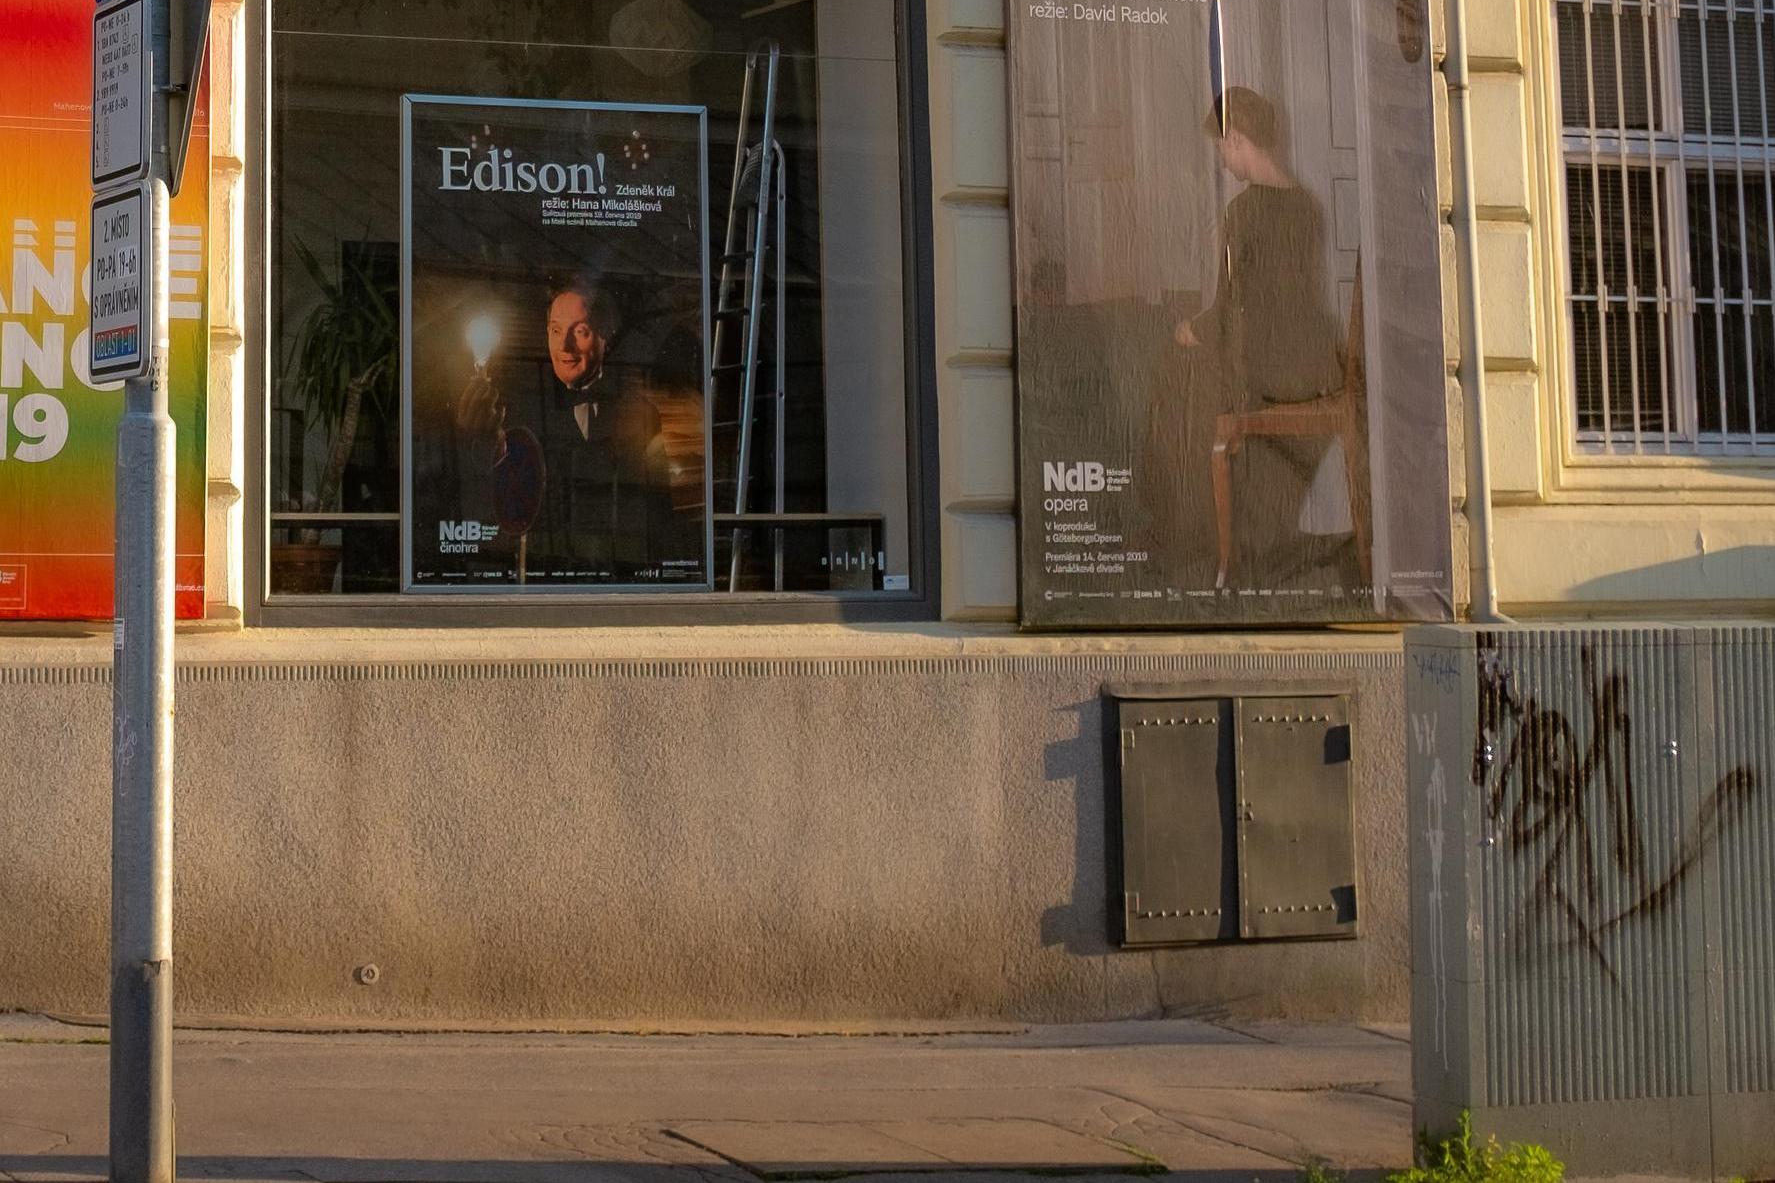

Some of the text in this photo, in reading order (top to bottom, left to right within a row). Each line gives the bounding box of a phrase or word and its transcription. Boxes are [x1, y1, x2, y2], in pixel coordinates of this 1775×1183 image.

[1028, 3, 1169, 25] režie: David Radok
[438, 146, 607, 194] Edison!
[616, 184, 675, 197] Zdeněk Král
[541, 198, 662, 212] režie: Hana Mikolášková
[104, 210, 130, 243] 2. MÍSTO
[97, 248, 137, 282] PO-PÁ 19-6h
[94, 280, 139, 319] S OPRÁVNĚNÍM
[96, 330, 119, 359] OBLAST
[1044, 461, 1105, 492] NdB
[1044, 498, 1088, 516] opera
[439, 520, 481, 541] NdB
[1045, 522, 1052, 531] V
[440, 541, 478, 553] činohra
[1126, 551, 1148, 561] 2019
